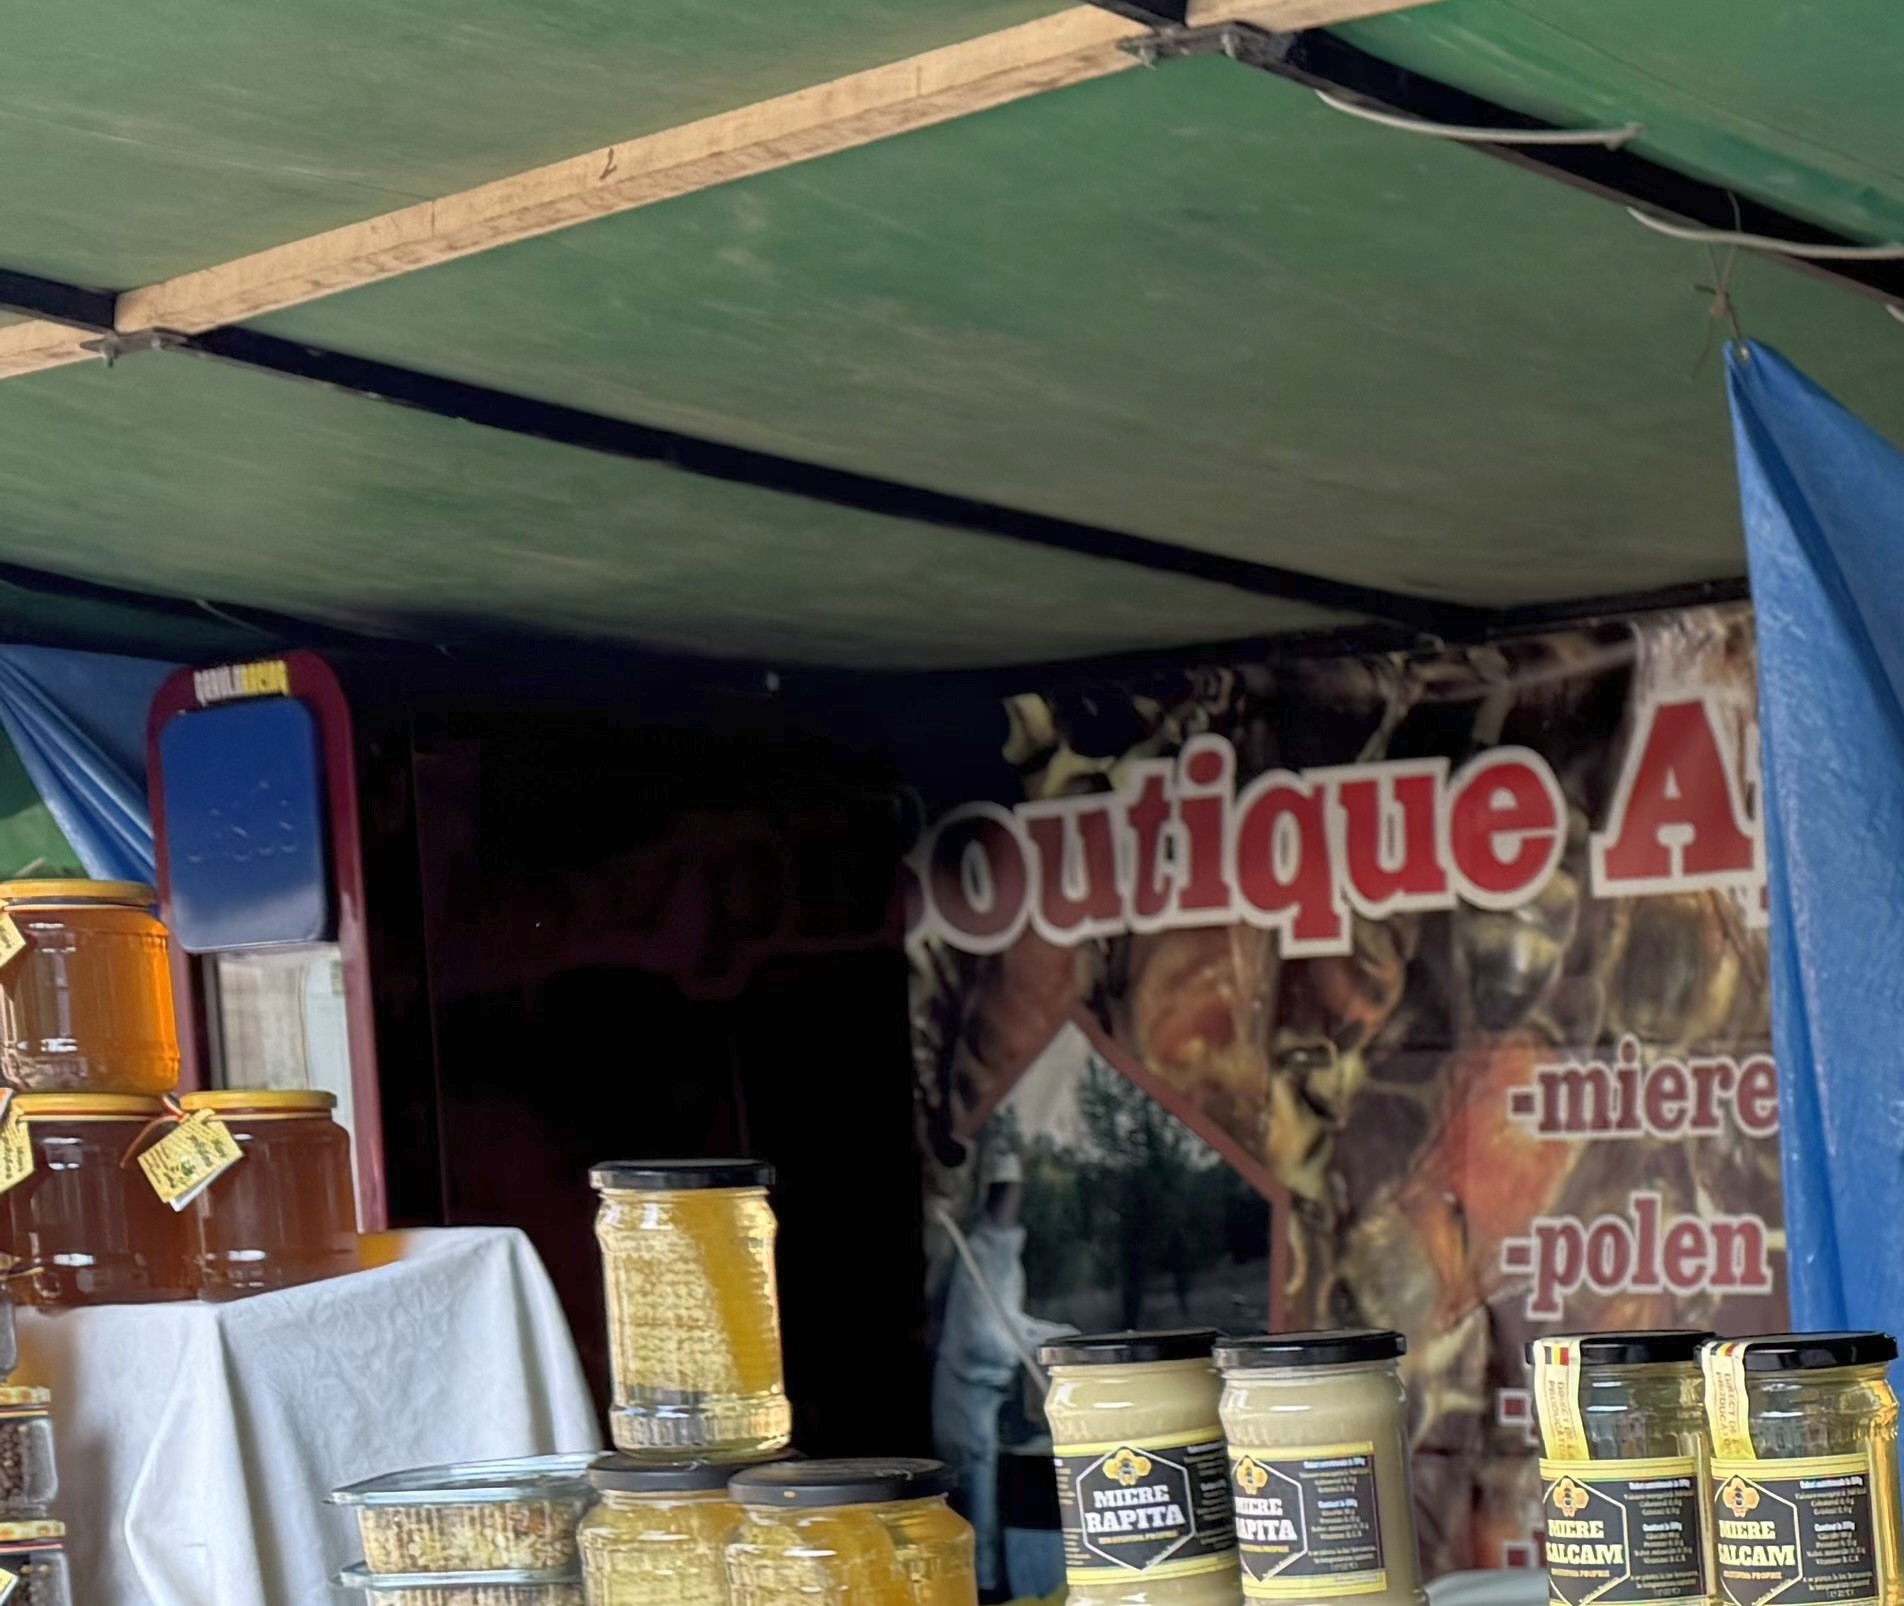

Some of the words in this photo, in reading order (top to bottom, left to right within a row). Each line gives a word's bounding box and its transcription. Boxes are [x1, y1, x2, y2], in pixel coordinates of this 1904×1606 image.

[905, 736, 1566, 957] outique
[1590, 692, 1768, 926] A
[1509, 1034, 1779, 1140] -miere
[1500, 1191, 1773, 1320] -polen
[1085, 1504, 1186, 1533] RAPITA
[1093, 1485, 1170, 1508] MIERE
